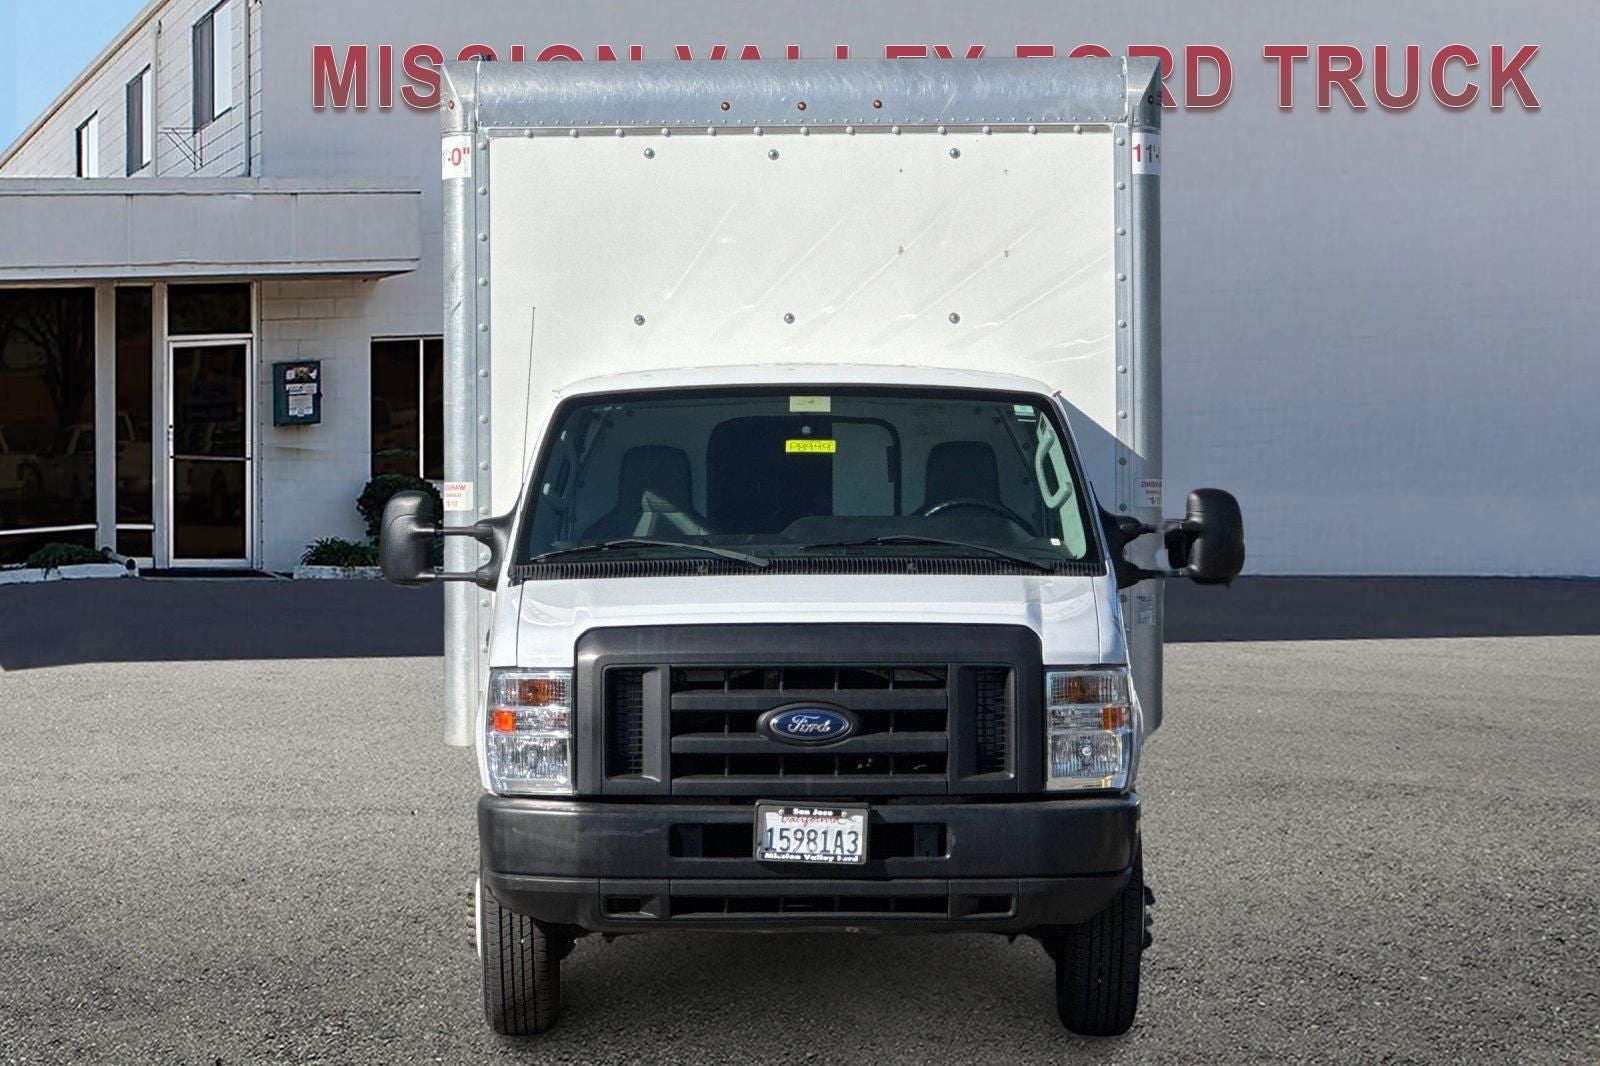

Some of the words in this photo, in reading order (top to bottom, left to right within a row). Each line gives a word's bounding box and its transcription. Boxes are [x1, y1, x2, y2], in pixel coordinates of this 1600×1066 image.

[1263, 44, 1541, 109] TRUCK
[787, 714, 831, 733] Ford
[793, 808, 810, 816] San
[765, 827, 859, 854] 15981A3
[804, 854, 835, 862] Valley
